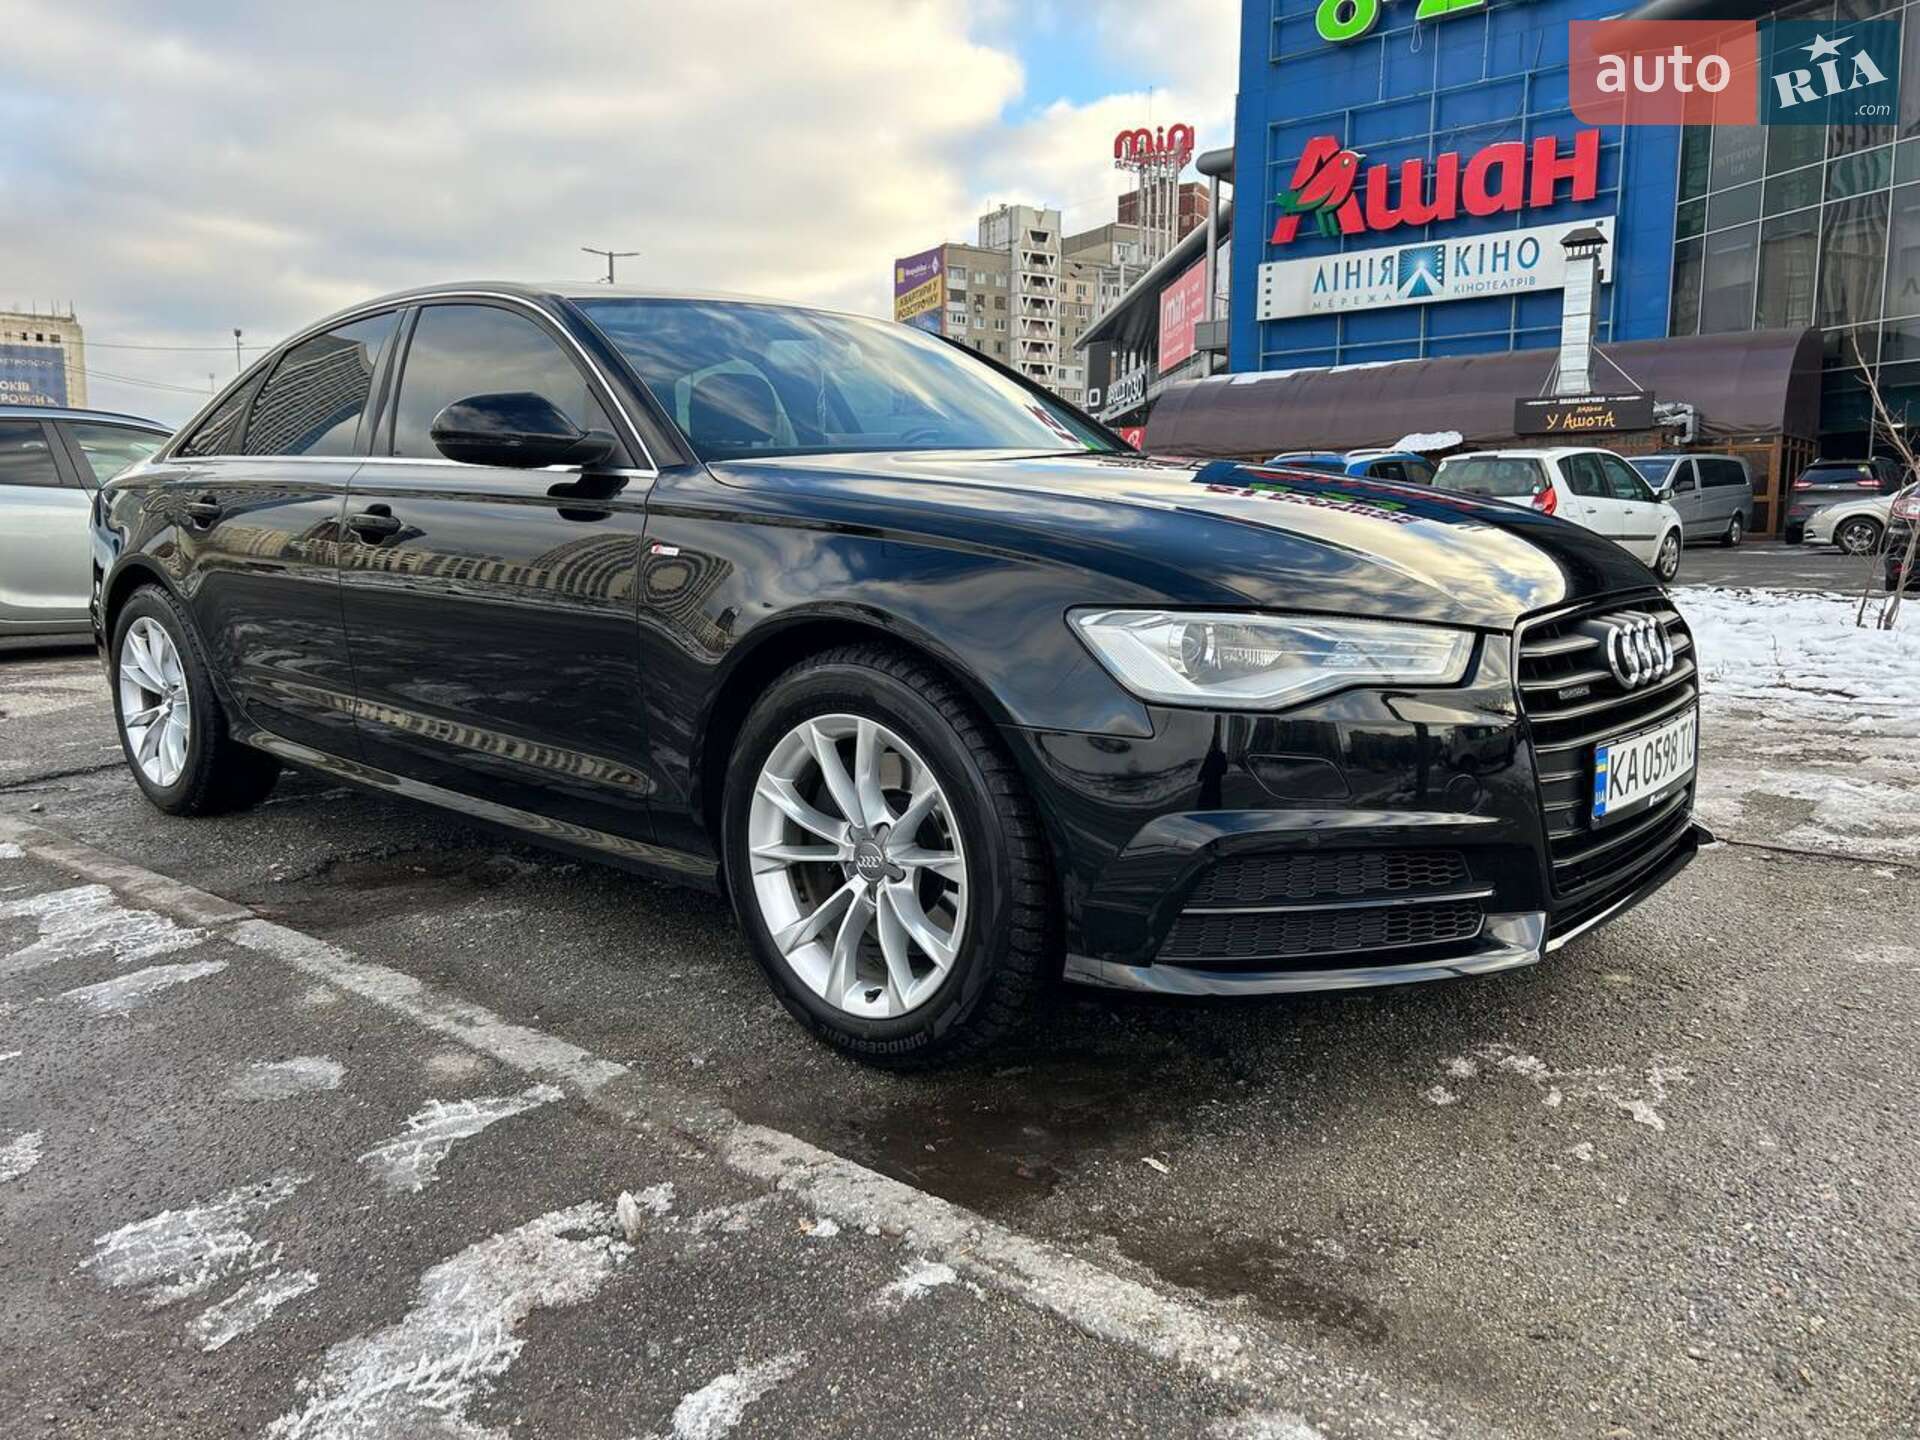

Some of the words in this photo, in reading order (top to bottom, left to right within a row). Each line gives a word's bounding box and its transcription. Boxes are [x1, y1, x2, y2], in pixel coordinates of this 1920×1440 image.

[1271, 129, 1599, 244] Ашан
[1312, 255, 1395, 294] ЛІНІЯ
[1453, 236, 1540, 277] КІНО
[1453, 275, 1537, 293] КІНОТЕАТРІВ
[1312, 293, 1393, 311] МЕРЕЖА
[1546, 414, 1559, 430] У
[1562, 411, 1617, 429] АШОТА
[1609, 747, 1639, 801] KA
[1643, 729, 1679, 786] 0598
